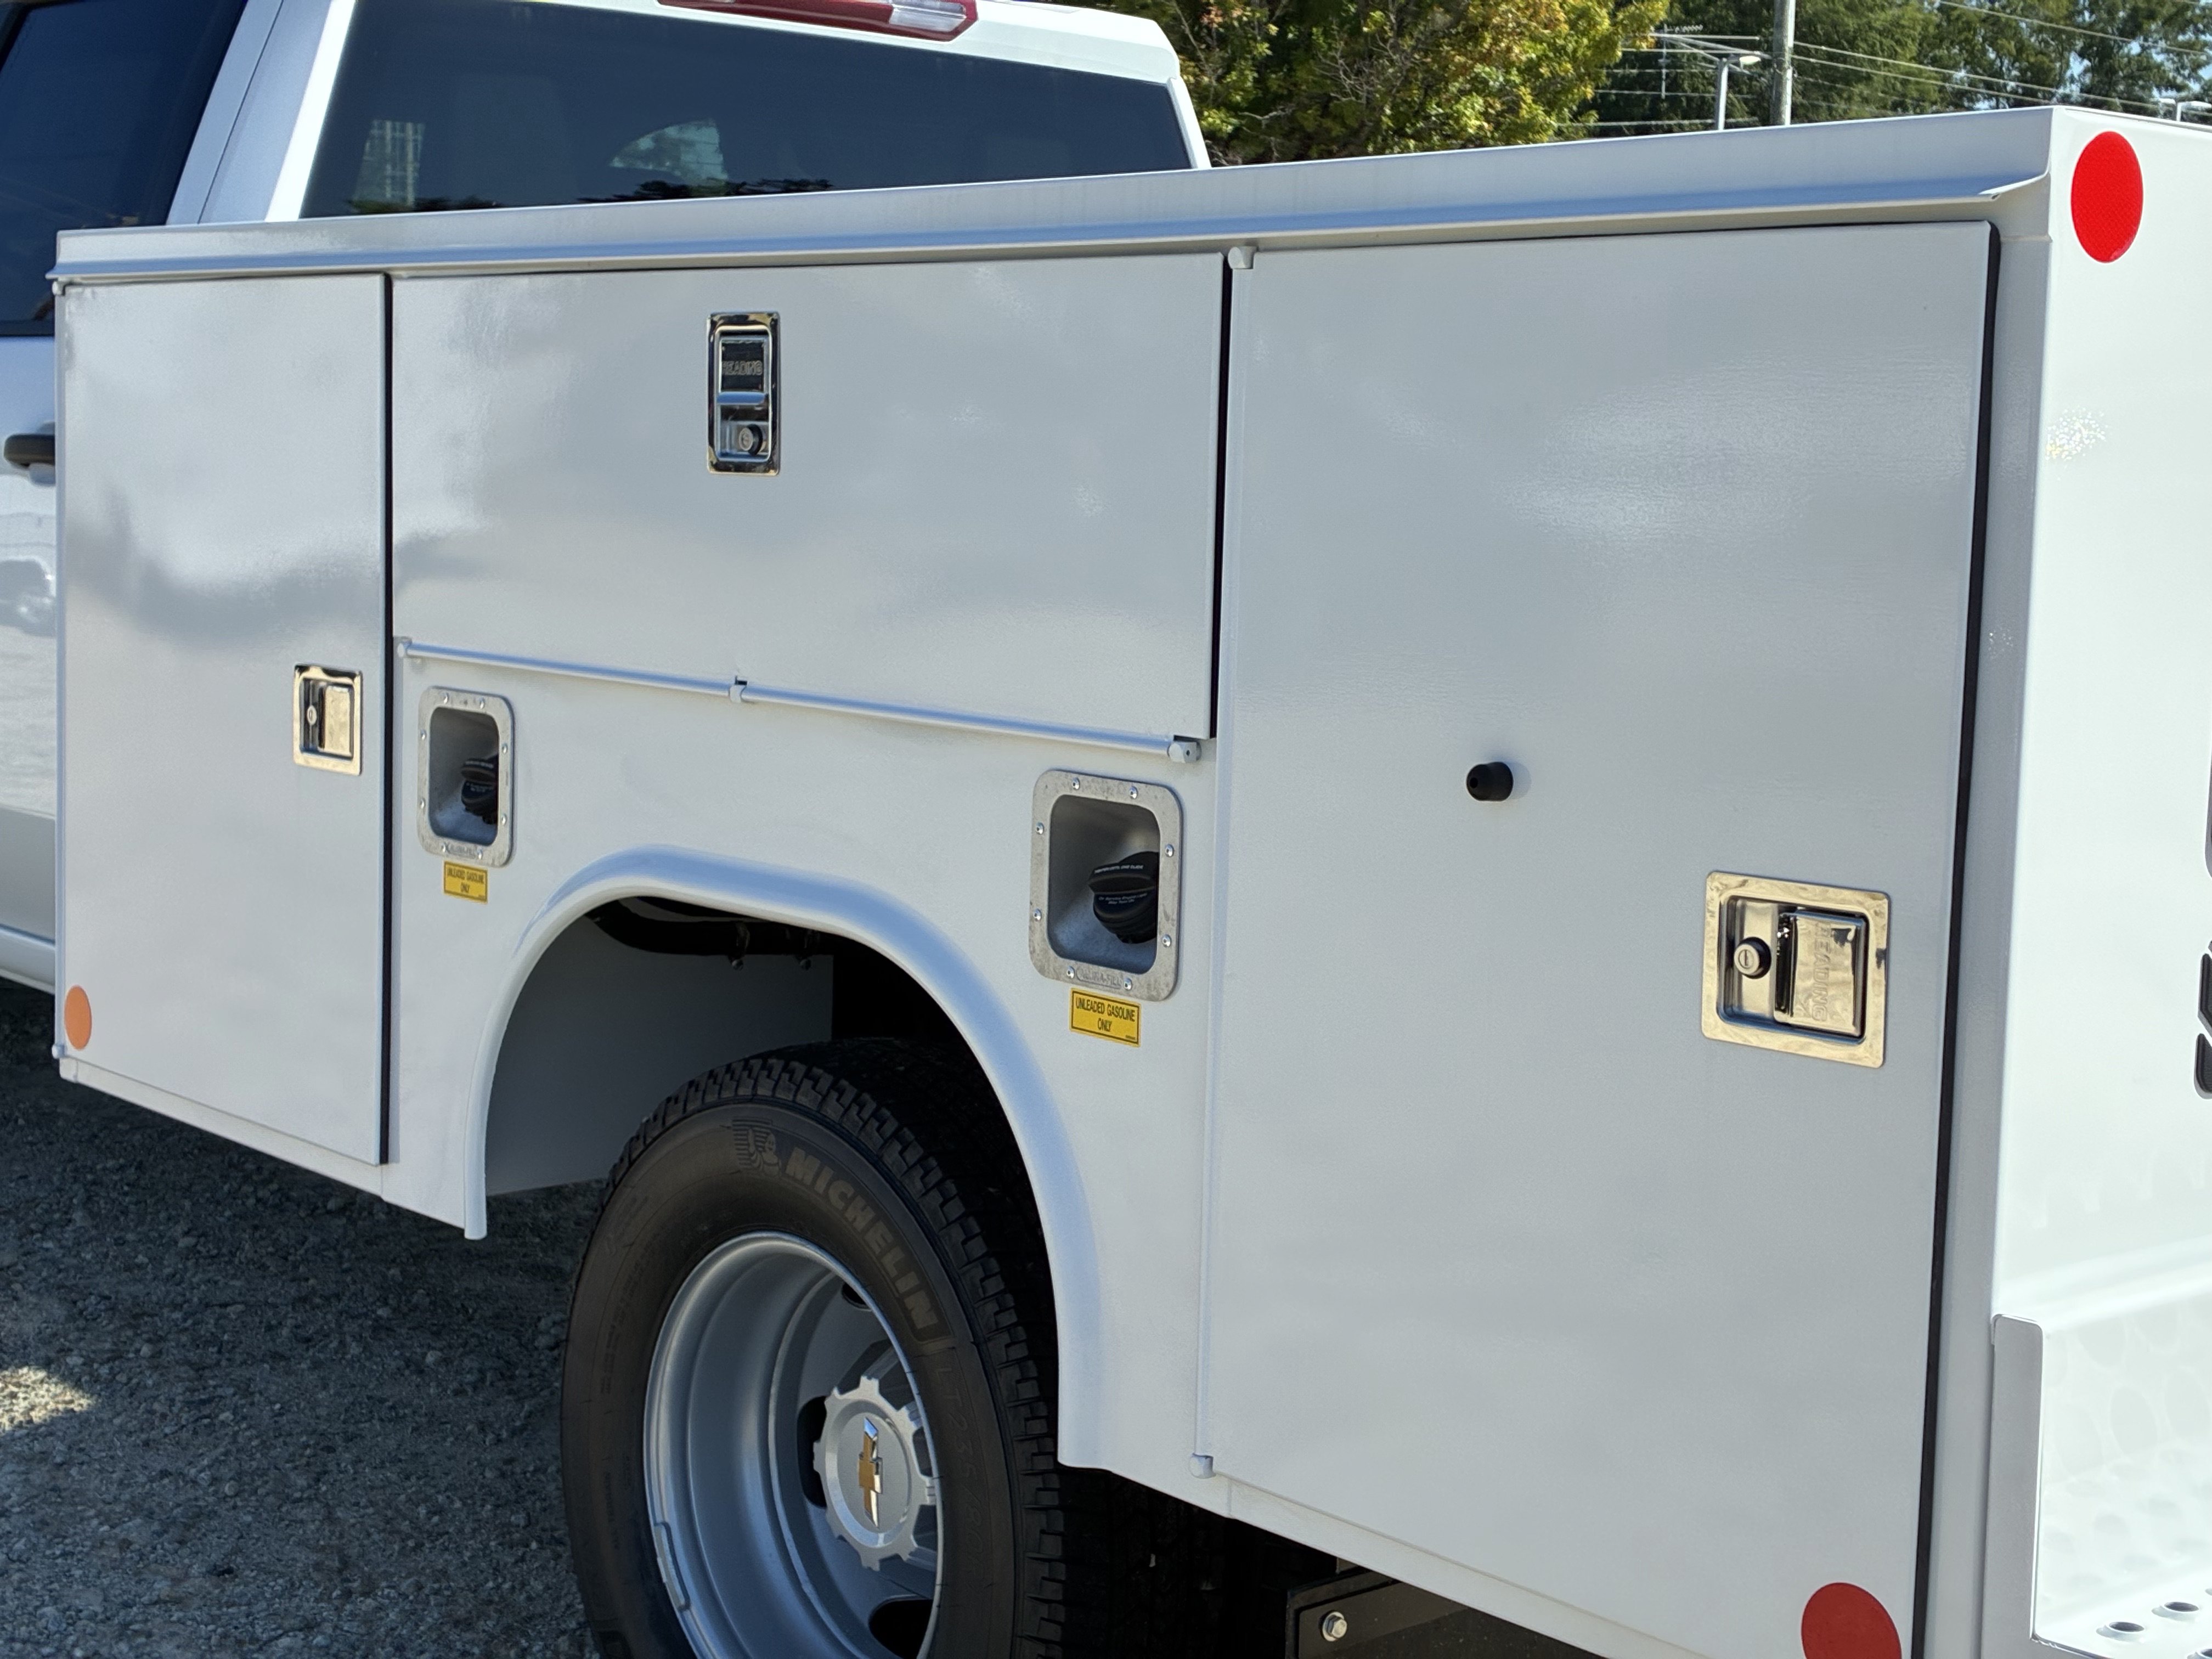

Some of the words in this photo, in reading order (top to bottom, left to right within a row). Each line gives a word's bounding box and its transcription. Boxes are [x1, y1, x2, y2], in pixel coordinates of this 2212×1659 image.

[722, 360, 762, 375] READING
[1812, 922, 1831, 1022] READING
[1076, 997, 1105, 1014] UNLEADED
[1107, 1004, 1136, 1022] GASOLINE
[1098, 1018, 1112, 1032] ONLY
[785, 1147, 939, 1330] MICHELIN
